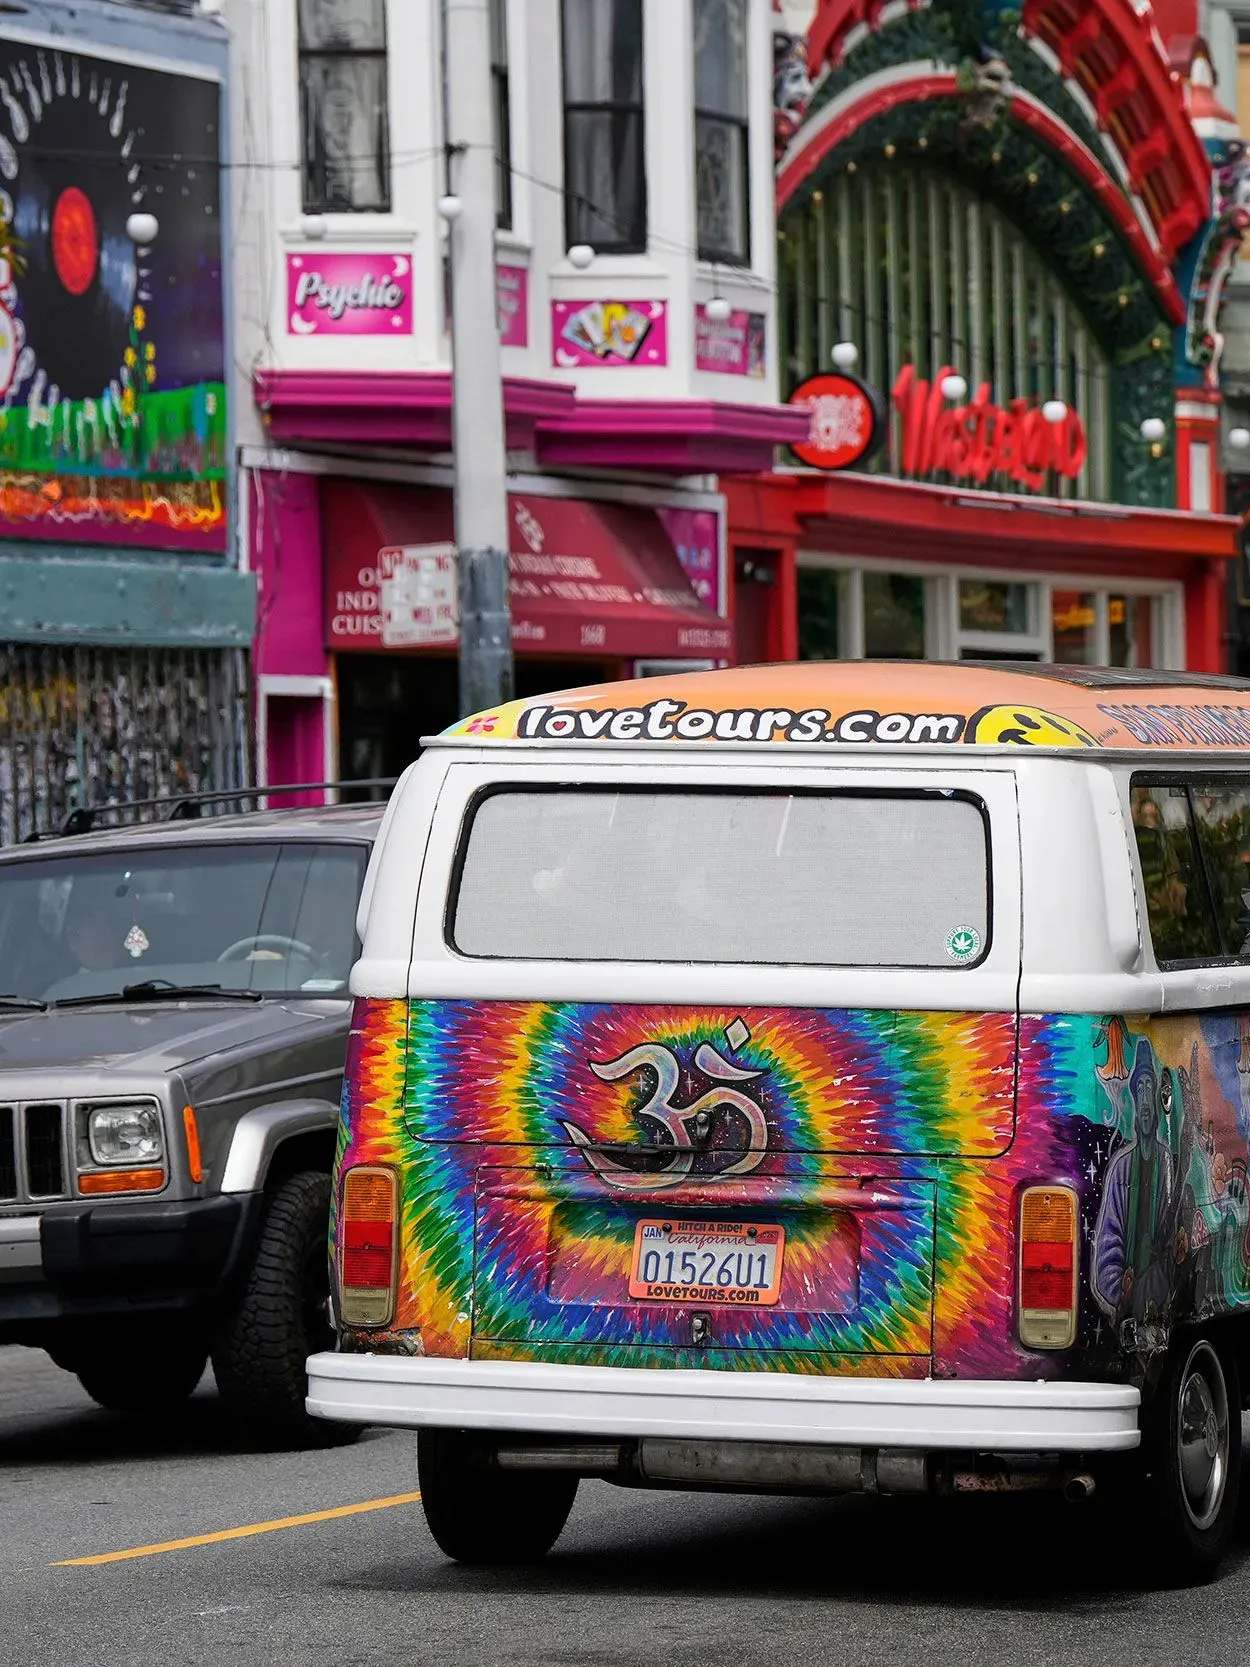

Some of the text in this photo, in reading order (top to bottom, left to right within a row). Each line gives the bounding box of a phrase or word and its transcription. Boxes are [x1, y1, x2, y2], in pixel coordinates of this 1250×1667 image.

[295, 272, 404, 319] Psychic
[520, 698, 963, 742] lovetours.com
[1097, 704, 1181, 745] SAN
[644, 1227, 662, 1238] JAN
[667, 1232, 756, 1250] California
[678, 1222, 706, 1232] HITCH
[708, 1223, 715, 1232] A
[643, 1250, 770, 1288] 01526U1
